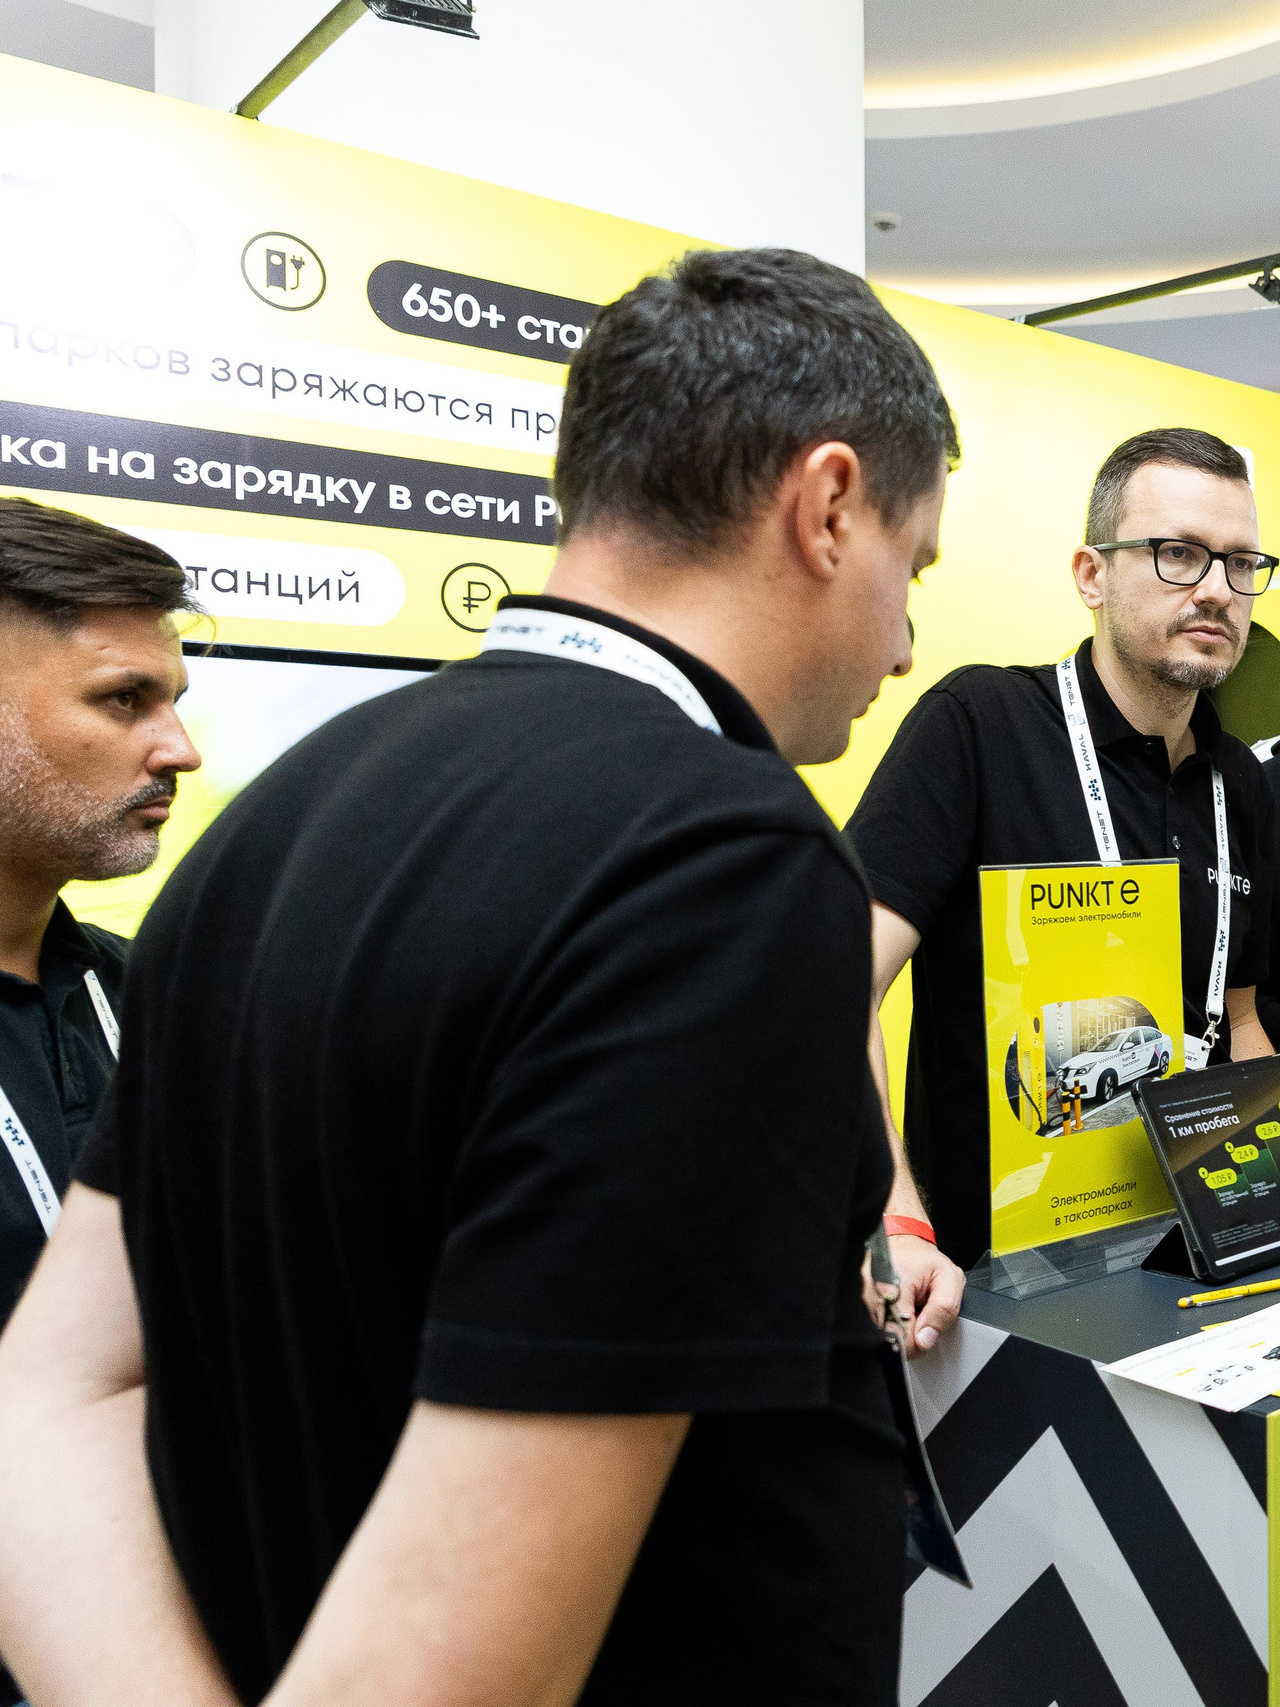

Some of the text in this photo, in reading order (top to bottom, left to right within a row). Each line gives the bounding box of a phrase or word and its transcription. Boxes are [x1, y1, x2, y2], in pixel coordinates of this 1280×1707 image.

[402, 283, 591, 349] 650+ ста
[211, 358, 493, 427] заряжаются
[511, 408, 556, 441] пр
[1, 434, 66, 469] ка
[88, 446, 155, 480] на
[173, 457, 377, 514] зарядку
[388, 485, 411, 511] в
[424, 488, 520, 525] сети
[185, 565, 359, 605] танций
[1078, 734, 1091, 771] HAVAL
[1030, 879, 1139, 910] PUNKT e
[1031, 910, 1142, 926] Заряжаем электромобили
[1164, 1103, 1234, 1123] Сравнение стоимости
[1168, 1115, 1240, 1138] 1 км пробега
[1050, 1181, 1137, 1208] Электромобили
[1055, 1200, 1133, 1226] в таксопарках
